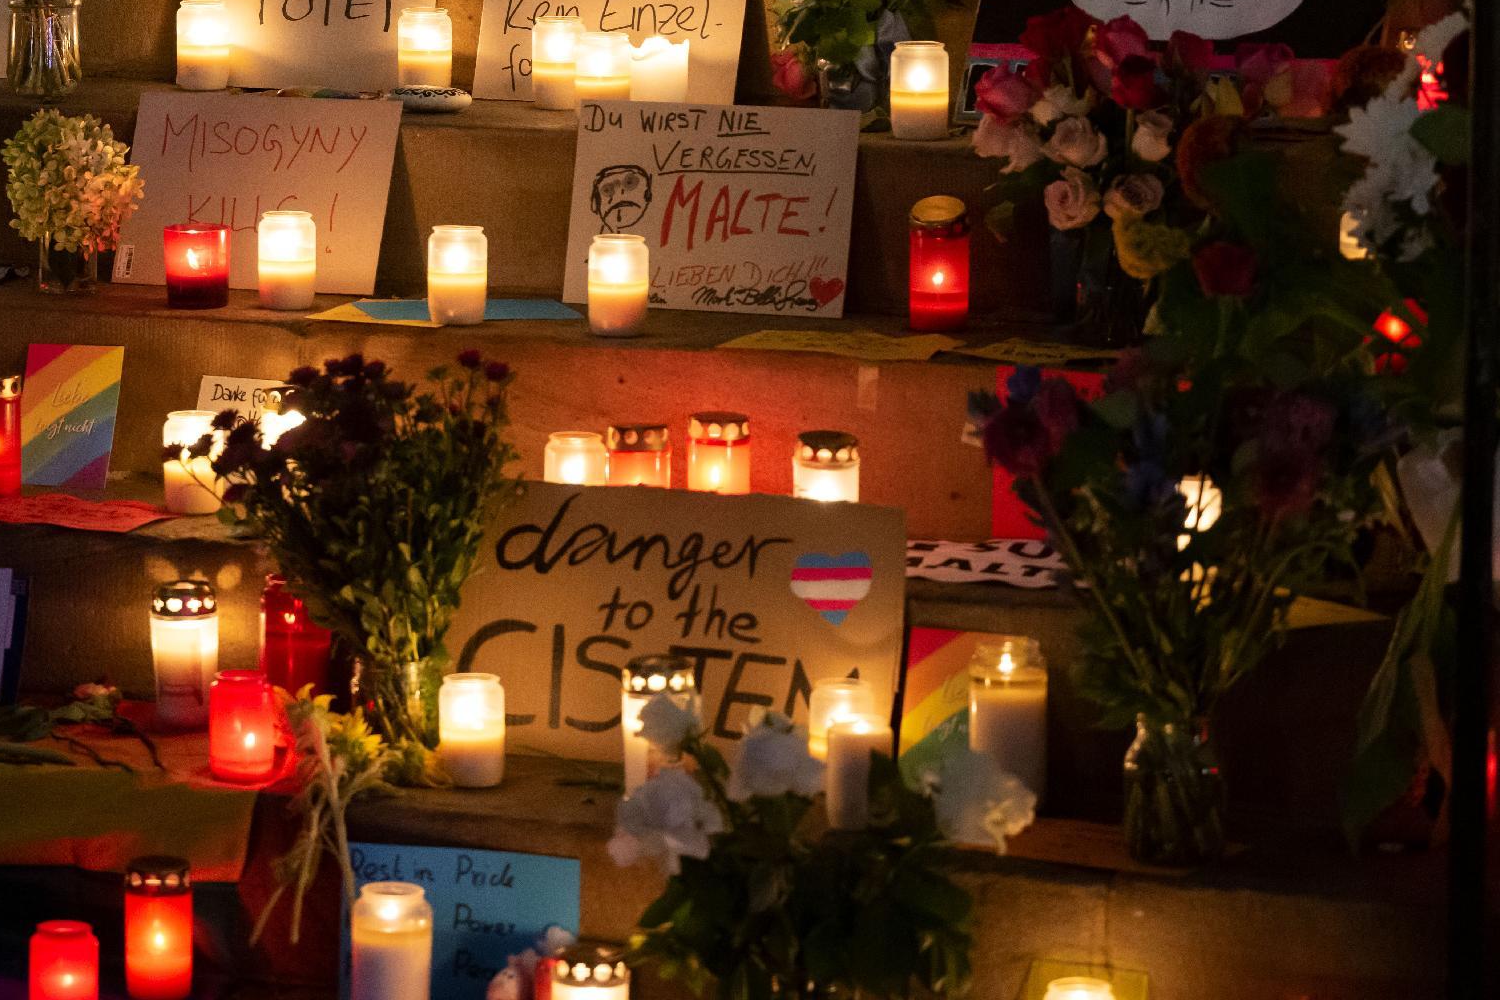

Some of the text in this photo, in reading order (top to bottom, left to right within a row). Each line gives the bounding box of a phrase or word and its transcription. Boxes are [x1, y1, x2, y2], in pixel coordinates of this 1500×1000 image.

[162, 113, 368, 173] MISOGYNY
[640, 108, 707, 134] WIRST
[717, 110, 763, 134] NIE
[210, 383, 248, 402] Danke
[495, 491, 795, 601] danger
[599, 583, 763, 644] to the
